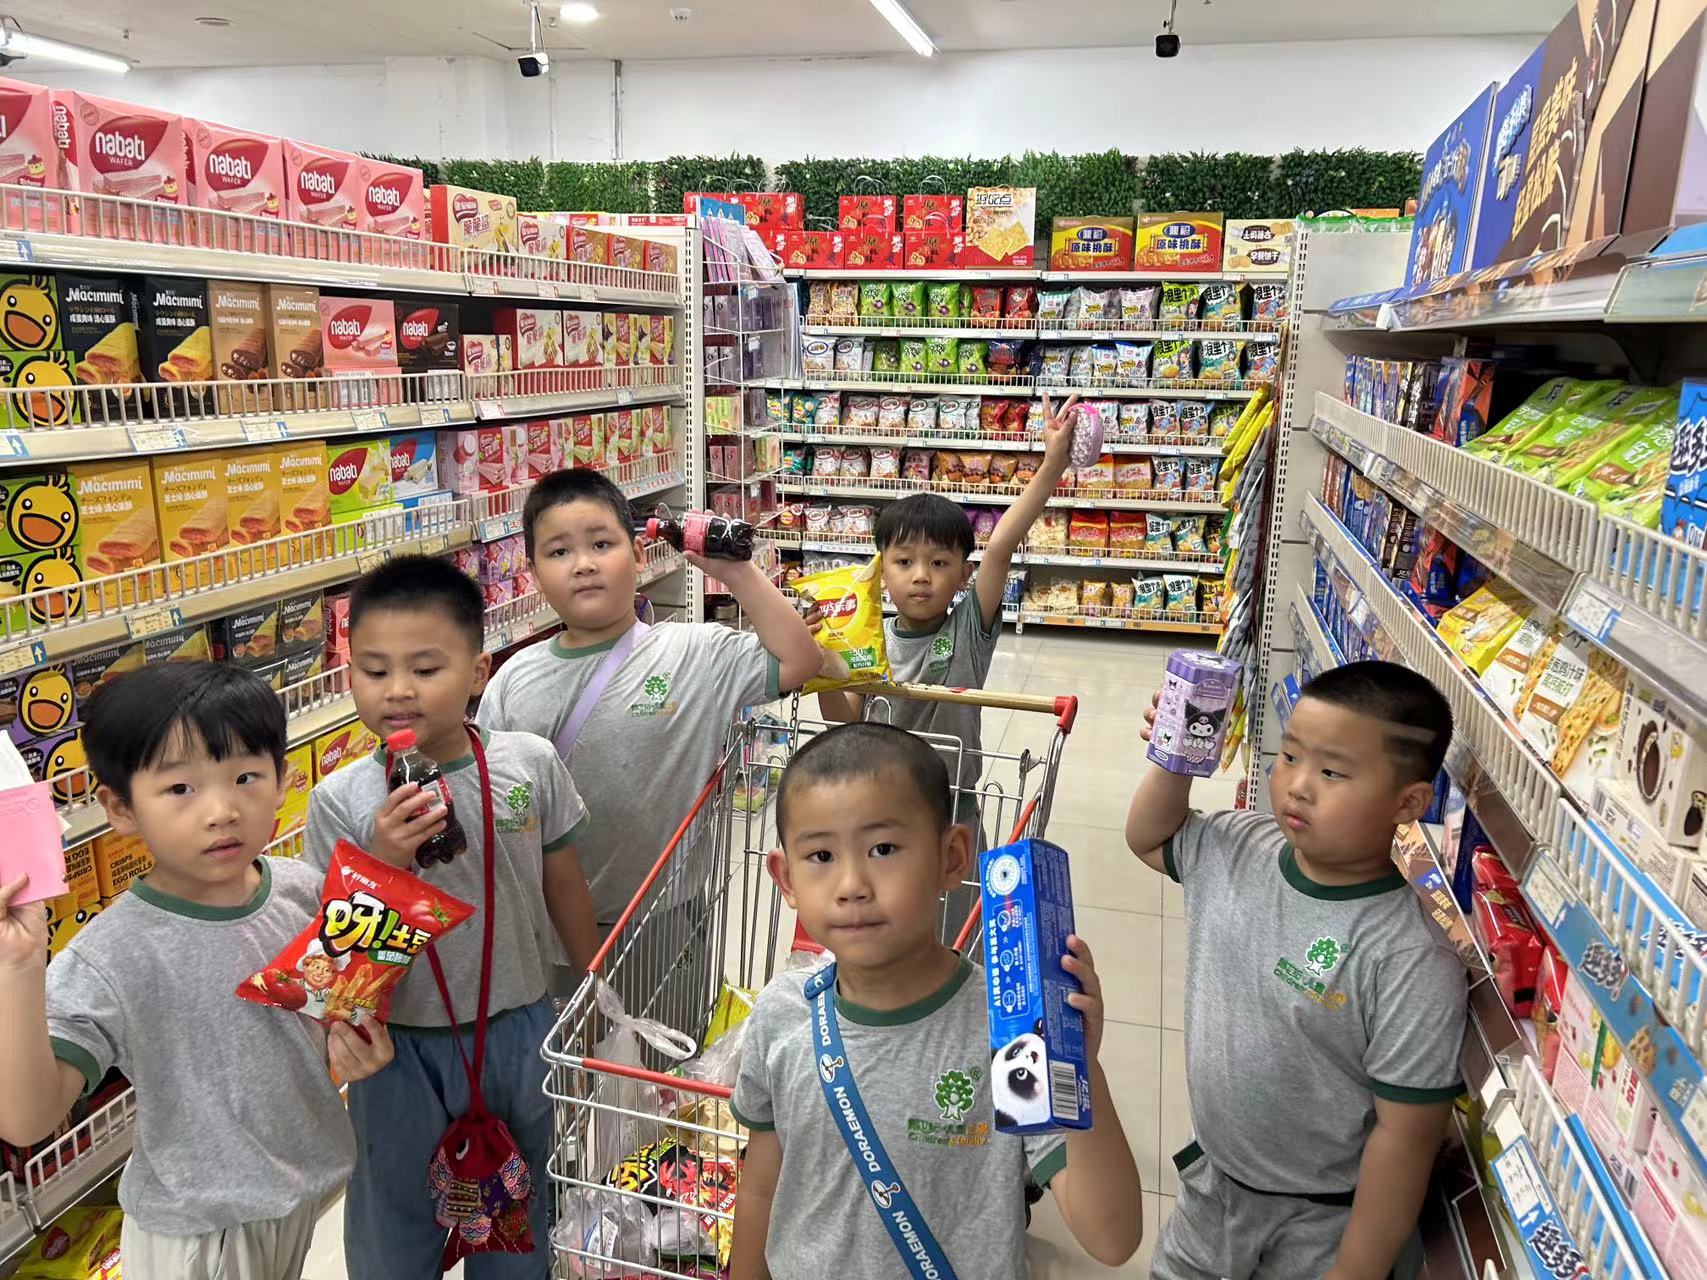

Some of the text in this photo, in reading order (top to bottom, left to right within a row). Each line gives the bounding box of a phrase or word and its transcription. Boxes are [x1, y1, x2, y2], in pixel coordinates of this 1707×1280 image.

[95, 131, 145, 161] nabati
[109, 156, 133, 167] WAFER
[209, 152, 251, 179] nabati
[222, 176, 241, 185] WAFER
[301, 170, 335, 194] nabati
[369, 185, 401, 207] nabati
[1071, 243, 1113, 254] 原味桃酥
[1156, 239, 1201, 250] 原味桃酥
[65, 288, 124, 304] Macimimi
[153, 293, 203, 309] Macimimi
[216, 294, 260, 310] Macimimi
[276, 297, 316, 312] Macimimi
[331, 319, 360, 335] nabati
[402, 321, 428, 336] nabati
[225, 460, 271, 476] Macimimi
[280, 454, 322, 468] Macimimi
[162, 467, 216, 484] Macimimi
[329, 462, 357, 481] nabati
[77, 476, 143, 495] Macimimi
[110, 854, 132, 869] CRISPS
[113, 874, 128, 886] EGG
[129, 861, 152, 878] ROLLS
[325, 891, 432, 954] 呀!土豆
[834, 1086, 881, 1173] DORAEMON
